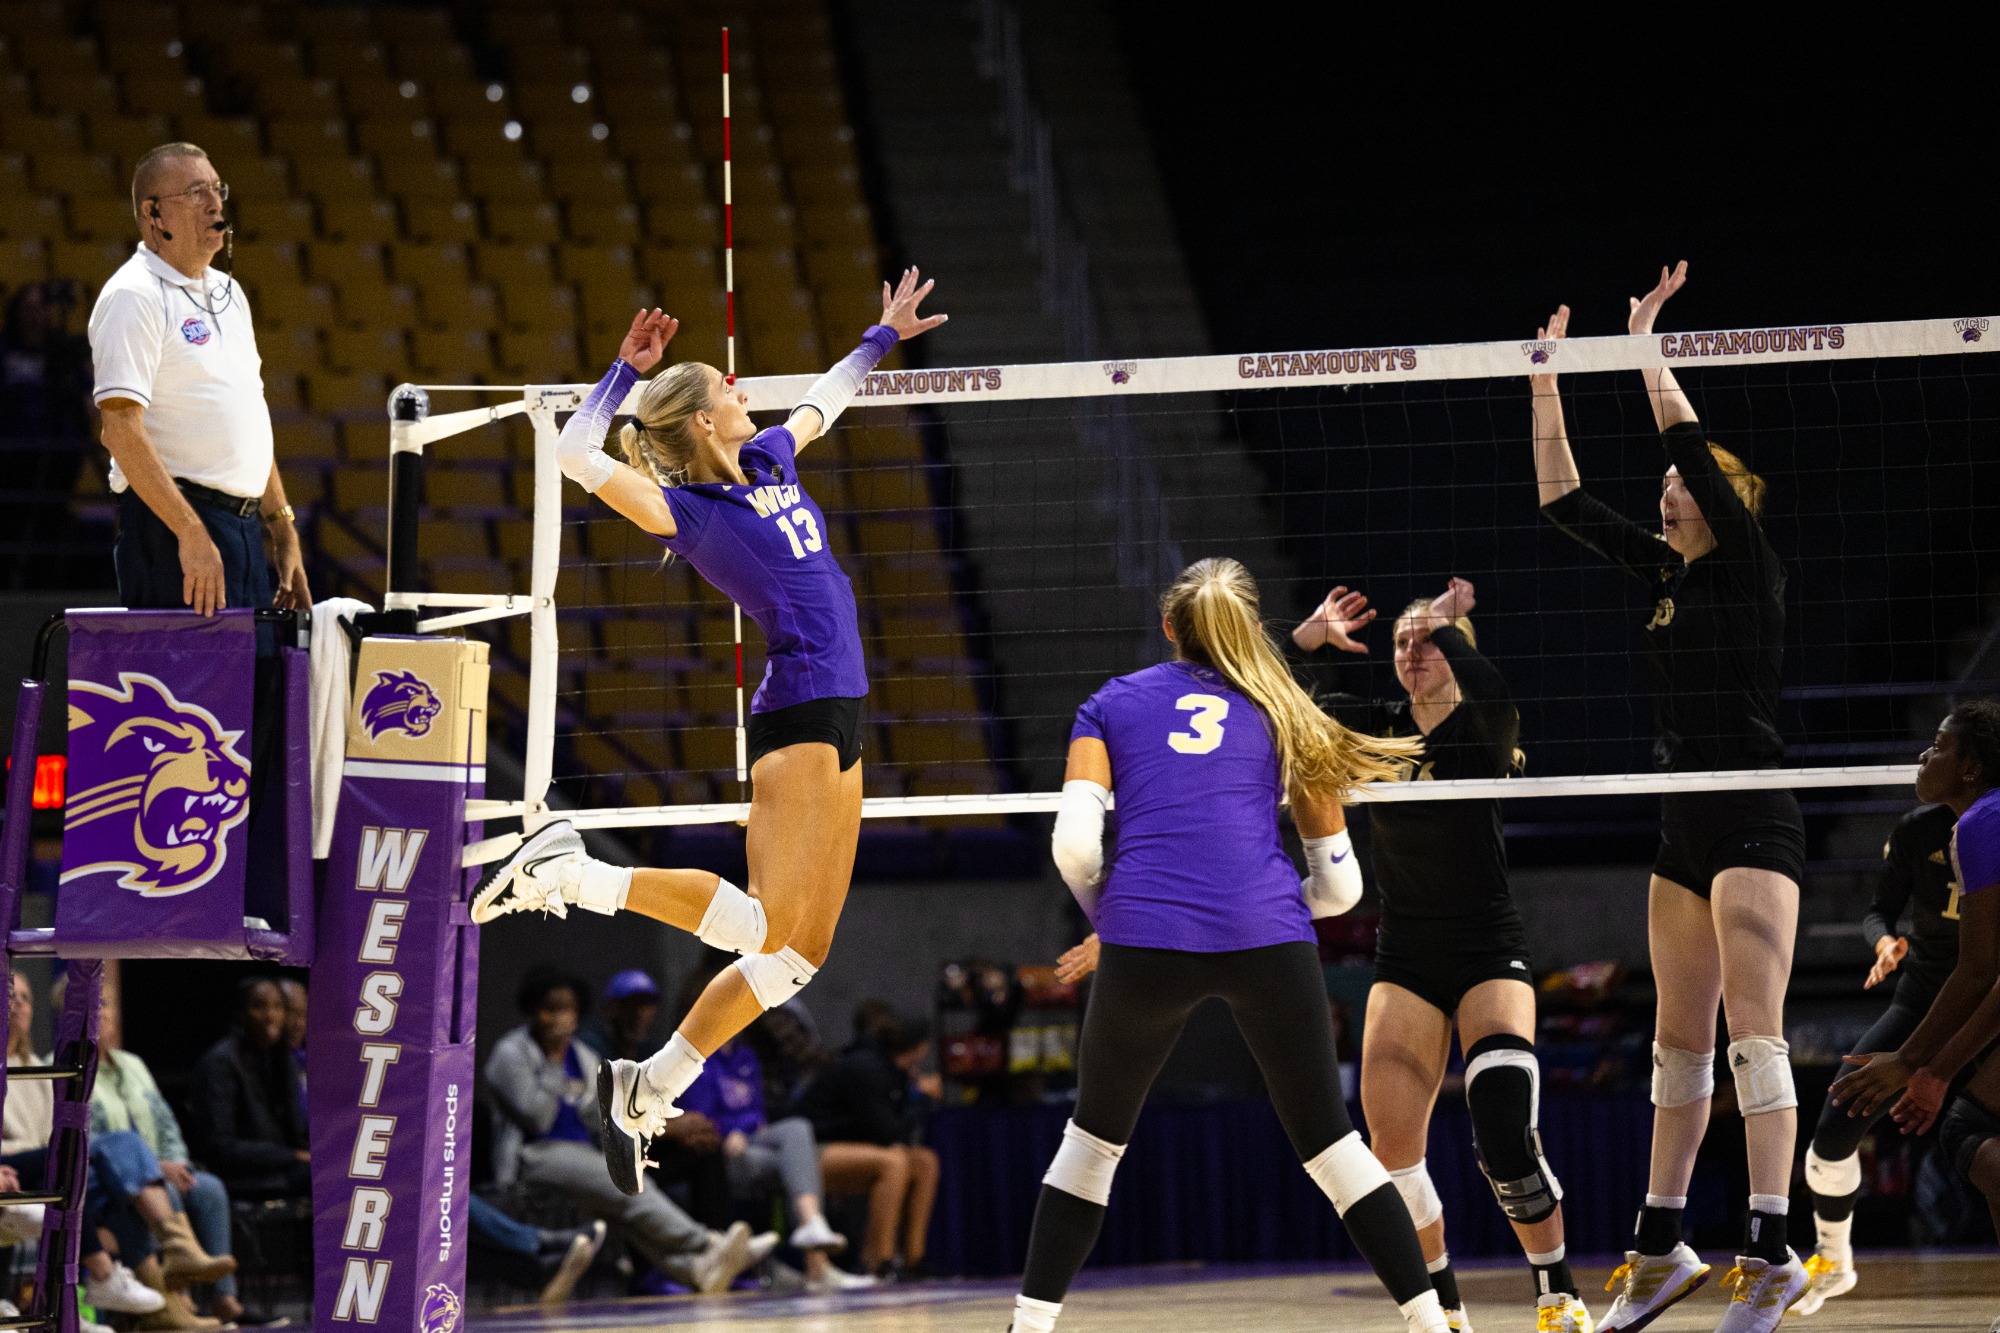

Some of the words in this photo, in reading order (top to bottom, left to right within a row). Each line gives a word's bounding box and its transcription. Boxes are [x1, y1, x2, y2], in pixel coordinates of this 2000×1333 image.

[1661, 326, 1845, 357] CATAMOUNTS
[1953, 318, 1989, 333] WCU
[1238, 348, 1417, 378] CATAMOUNTS
[1521, 341, 1556, 356] WCU
[855, 368, 1001, 396] TAMOUNTS
[745, 484, 800, 518] WCU
[776, 508, 822, 559] 13
[1167, 693, 1230, 754] 3
[332, 825, 430, 1324] WESTERN
[444, 1084, 458, 1162] sports
[439, 1166, 454, 1262] imports
